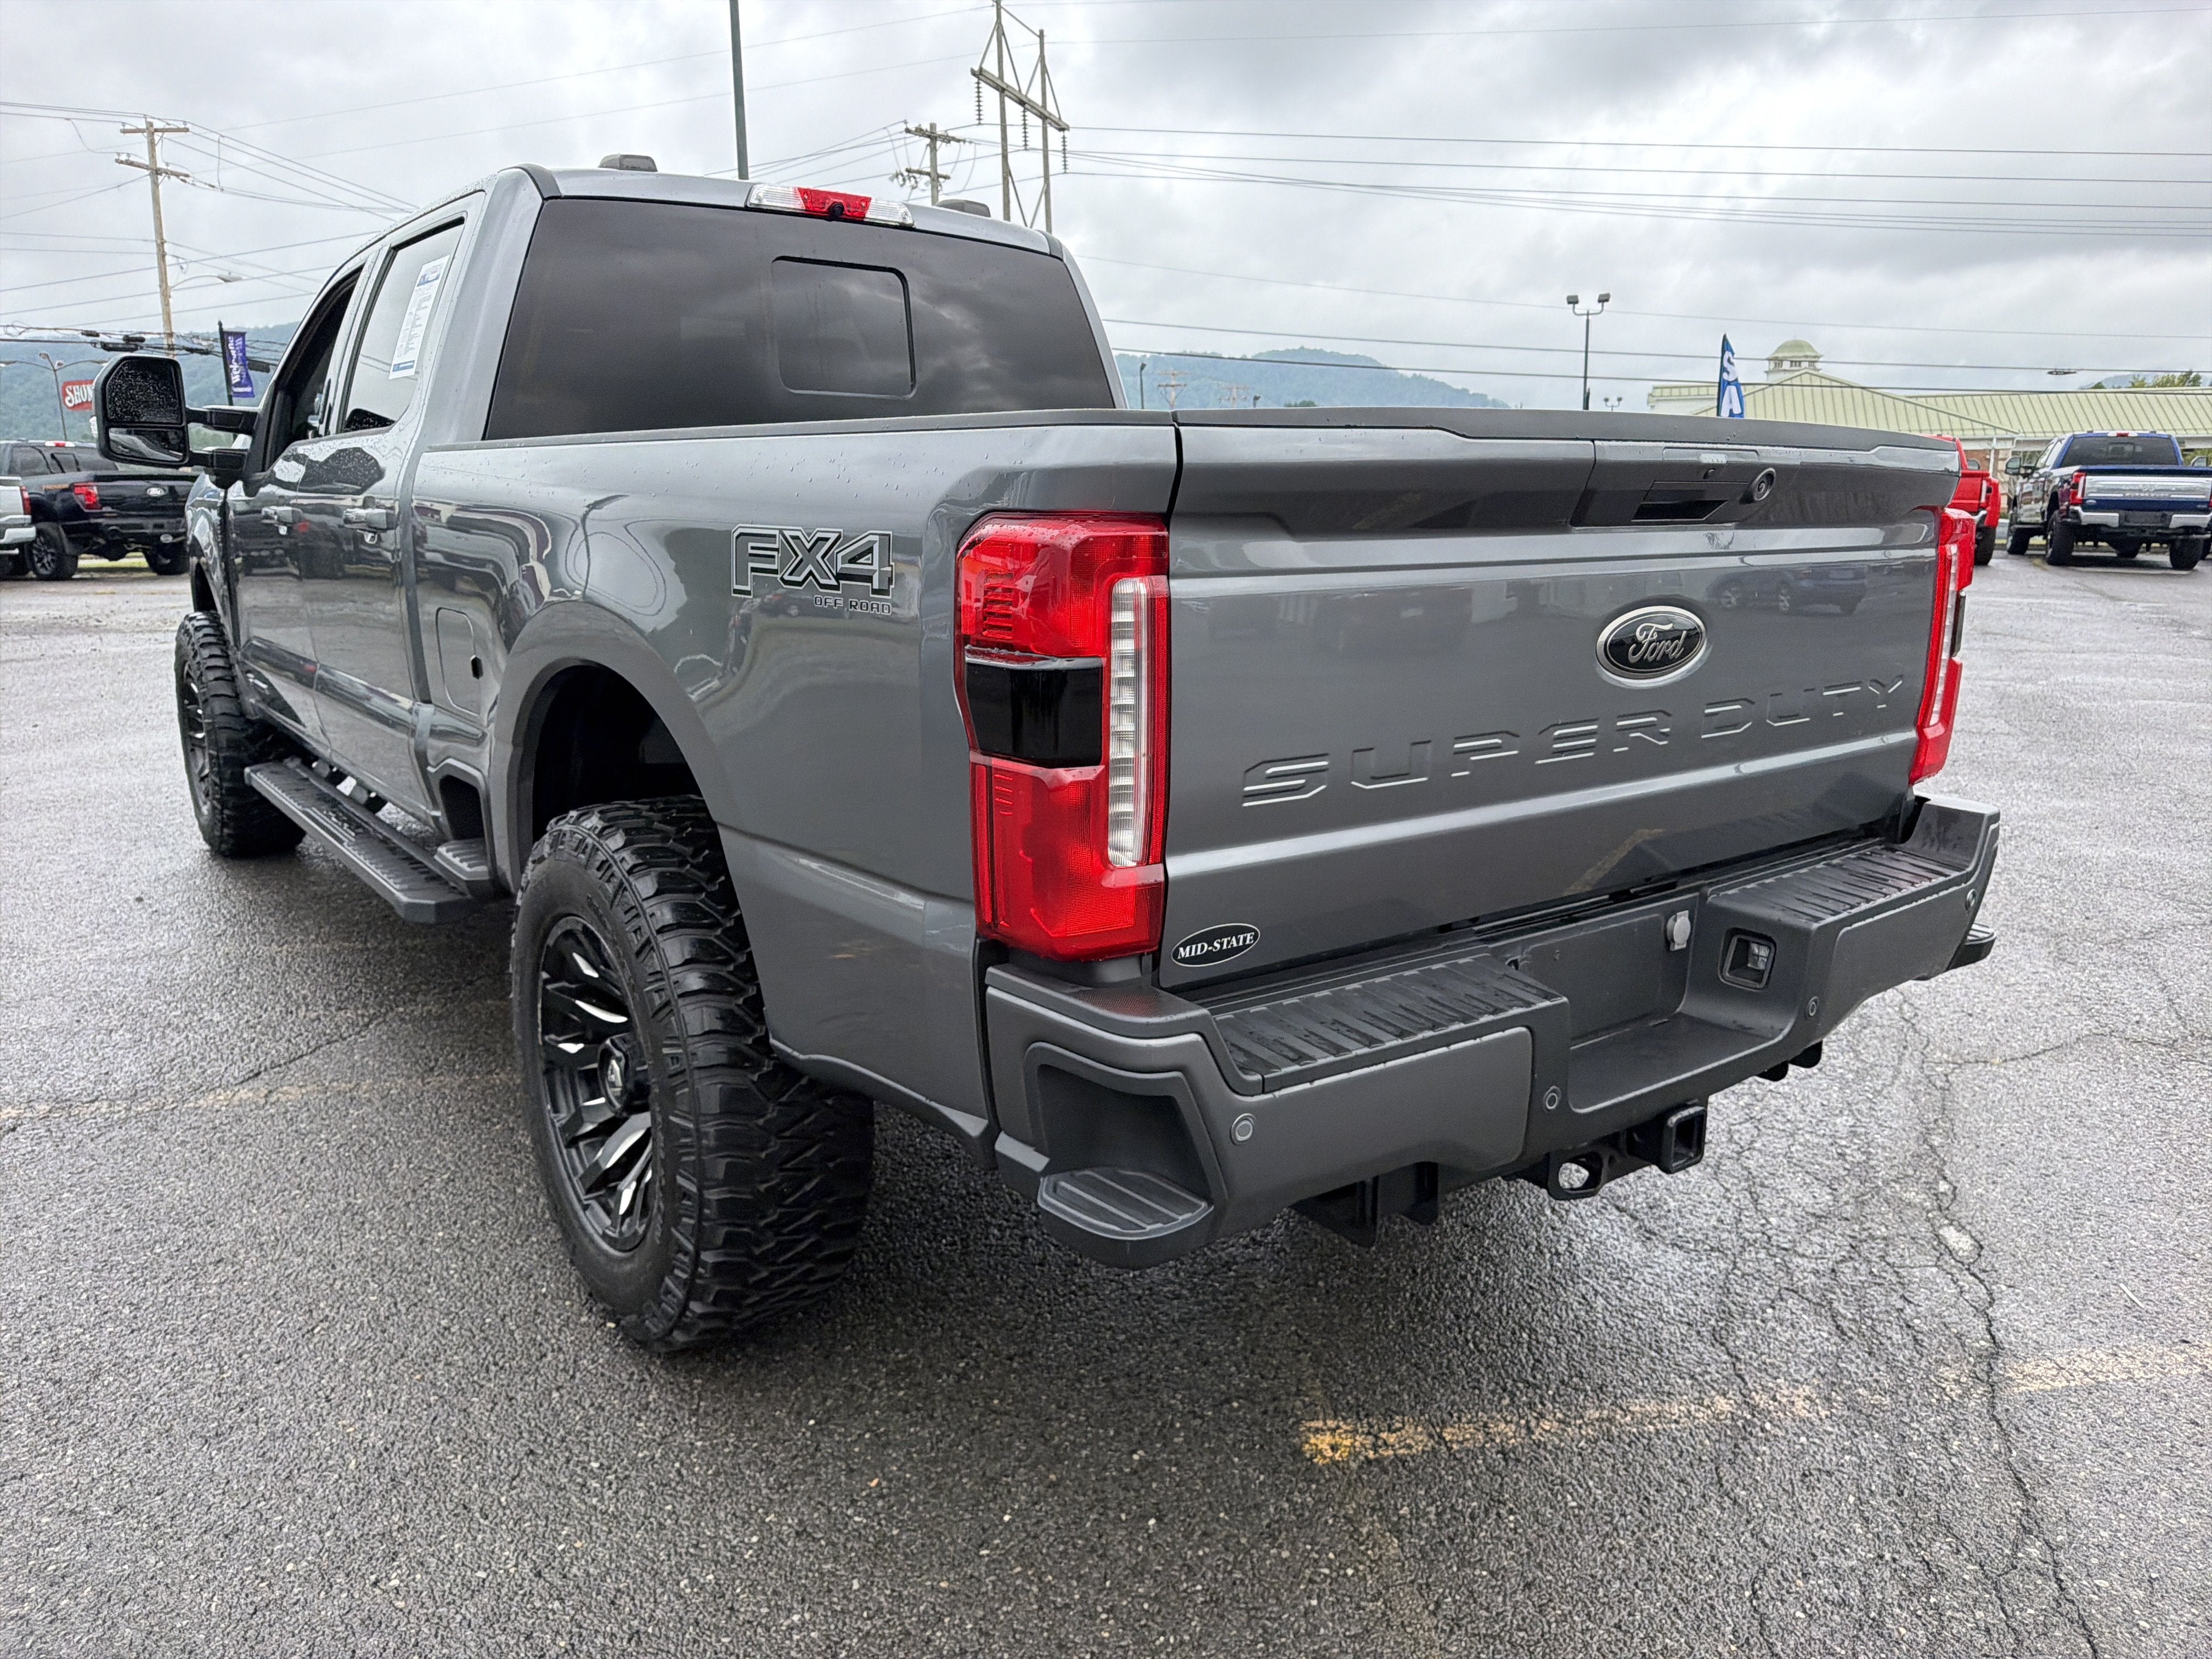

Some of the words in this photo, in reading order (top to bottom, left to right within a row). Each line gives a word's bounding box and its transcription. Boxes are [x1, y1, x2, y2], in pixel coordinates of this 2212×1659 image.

[731, 524, 895, 599] FX4
[813, 595, 844, 608] OFF
[848, 599, 892, 615] ROAD
[1628, 623, 1686, 664] Ford
[1242, 709, 1672, 806] SUPER
[1701, 674, 1904, 738] DUTY
[1177, 932, 1255, 959] MID-STATE
